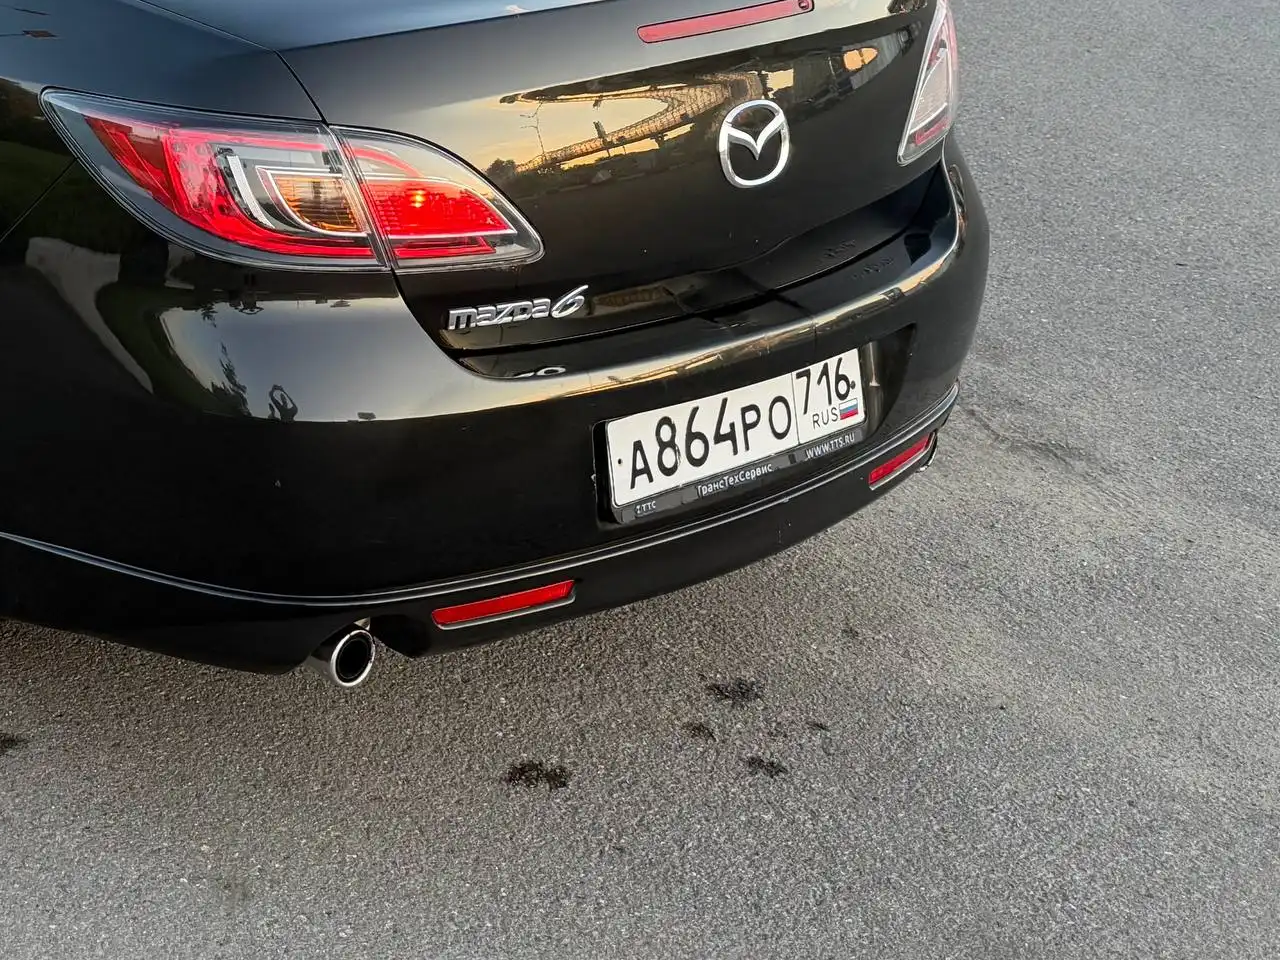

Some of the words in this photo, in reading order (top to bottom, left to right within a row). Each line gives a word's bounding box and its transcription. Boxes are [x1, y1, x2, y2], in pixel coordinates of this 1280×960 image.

[811, 406, 839, 431] RUS
[805, 432, 856, 460] WWW.TTS.RU
[696, 462, 773, 497] ТрансТехСервис
